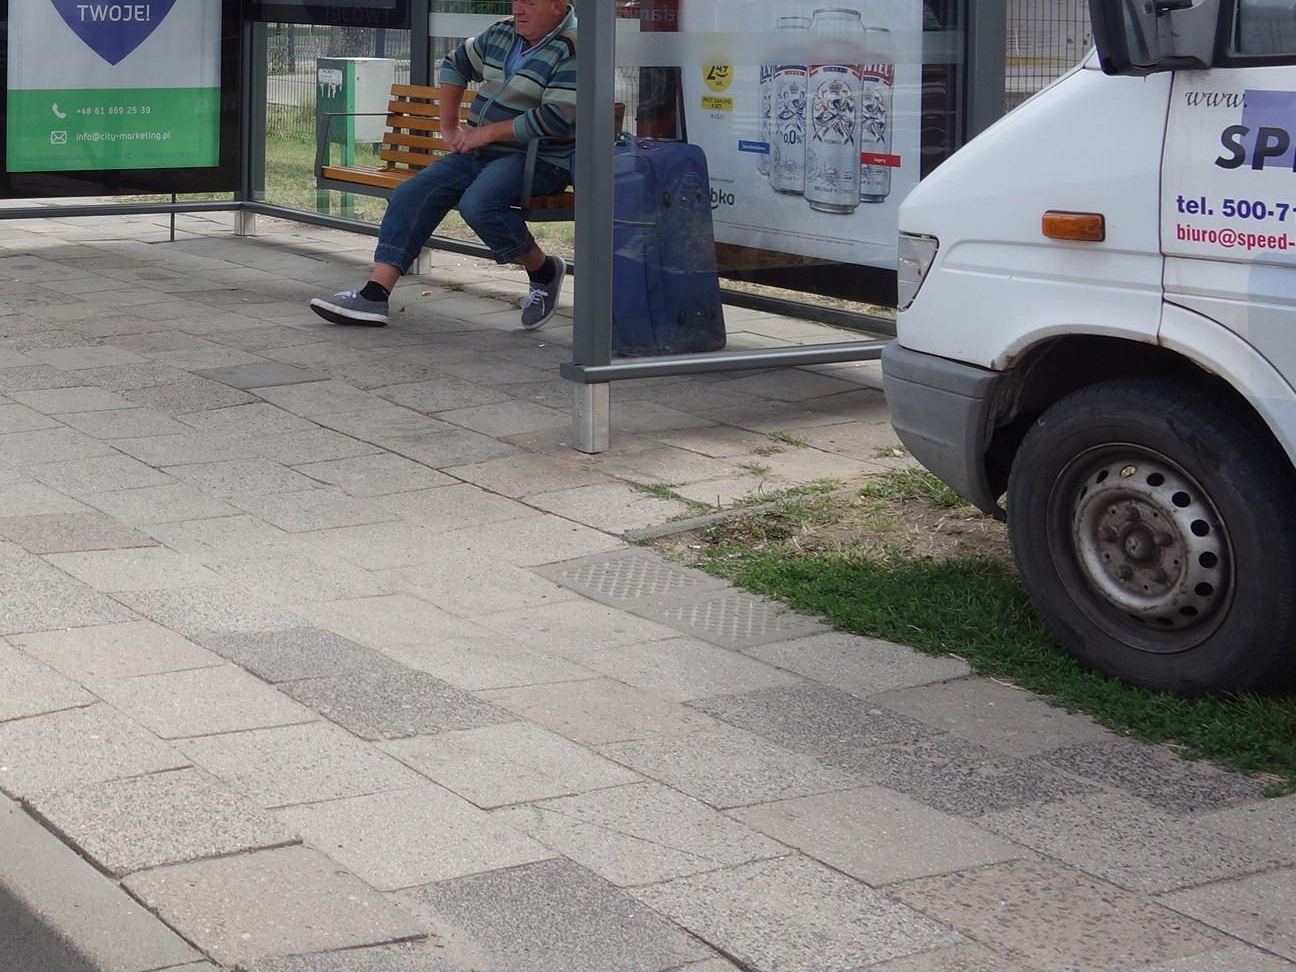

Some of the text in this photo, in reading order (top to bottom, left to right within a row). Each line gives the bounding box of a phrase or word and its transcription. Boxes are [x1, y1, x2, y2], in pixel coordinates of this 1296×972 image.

[76, 4, 150, 22] TWOJE!
[1185, 91, 1248, 109] www.
[94, 107, 105, 115] 61
[108, 106, 124, 115] 869
[126, 106, 137, 114] 25
[140, 106, 151, 114] 39
[76, 131, 171, 142] info@city-marketing.pl
[1214, 124, 1296, 173] SP
[709, 188, 735, 207] bka
[1176, 195, 1296, 222] tel. 500-7
[1176, 224, 1296, 251] biuro@speed-
